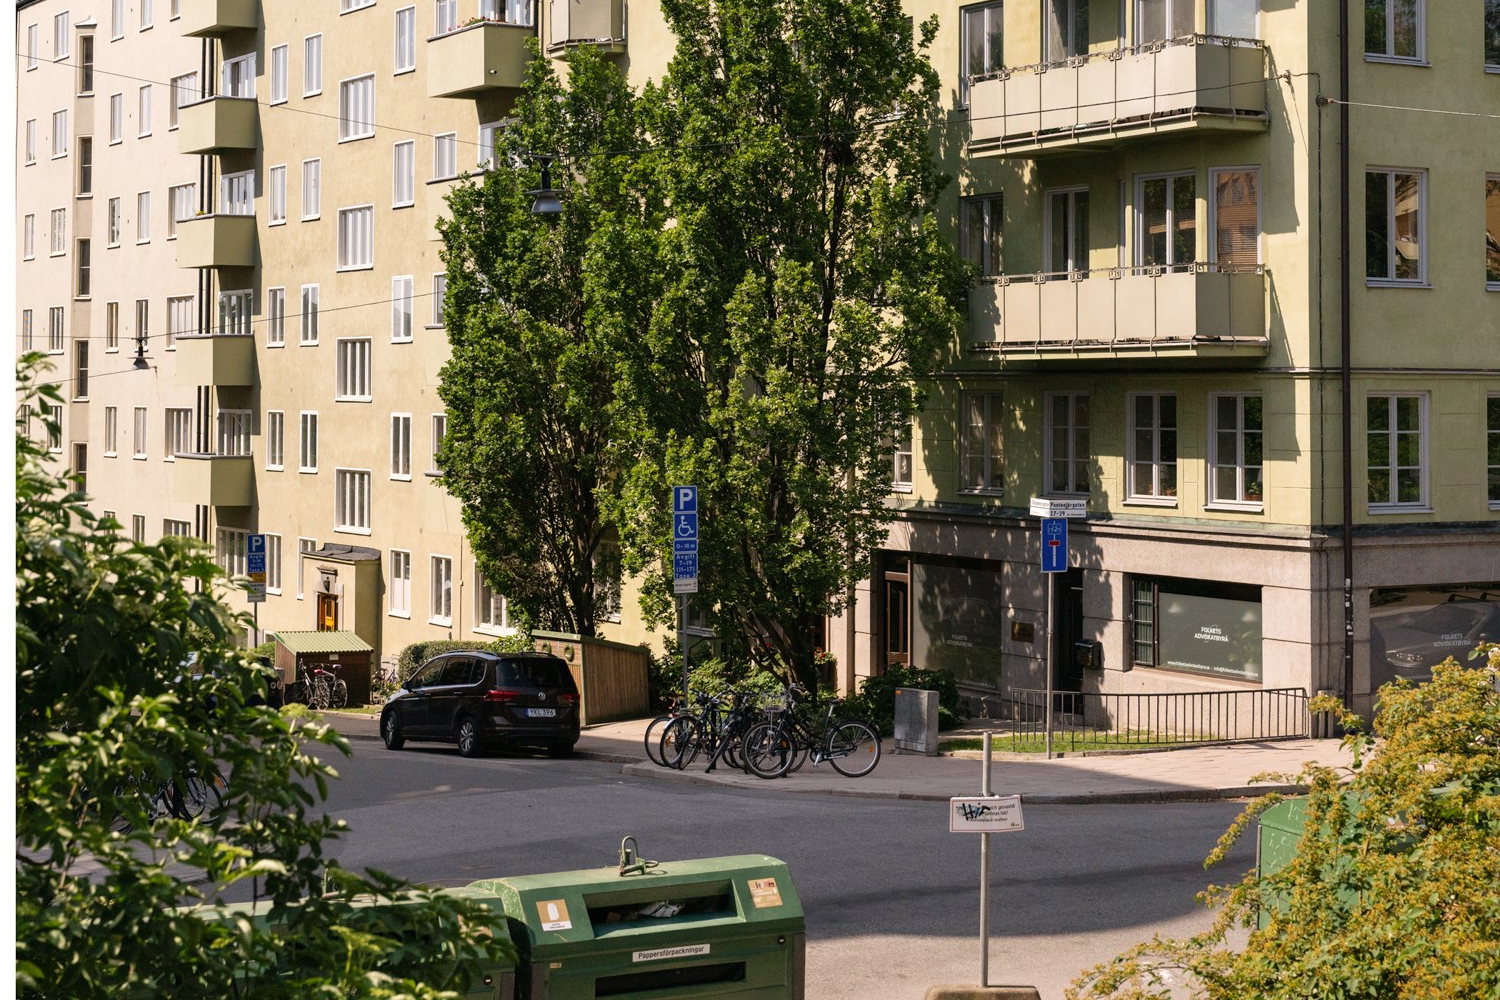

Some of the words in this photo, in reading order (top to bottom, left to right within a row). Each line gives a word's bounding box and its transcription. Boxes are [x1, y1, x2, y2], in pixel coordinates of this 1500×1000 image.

[680, 488, 693, 510] P
[252, 536, 262, 552] P
[1201, 626, 1221, 635] FOLKETS
[1194, 633, 1229, 642] ADVOKATBYRÅ
[638, 946, 705, 959] Pappersförpackningar
